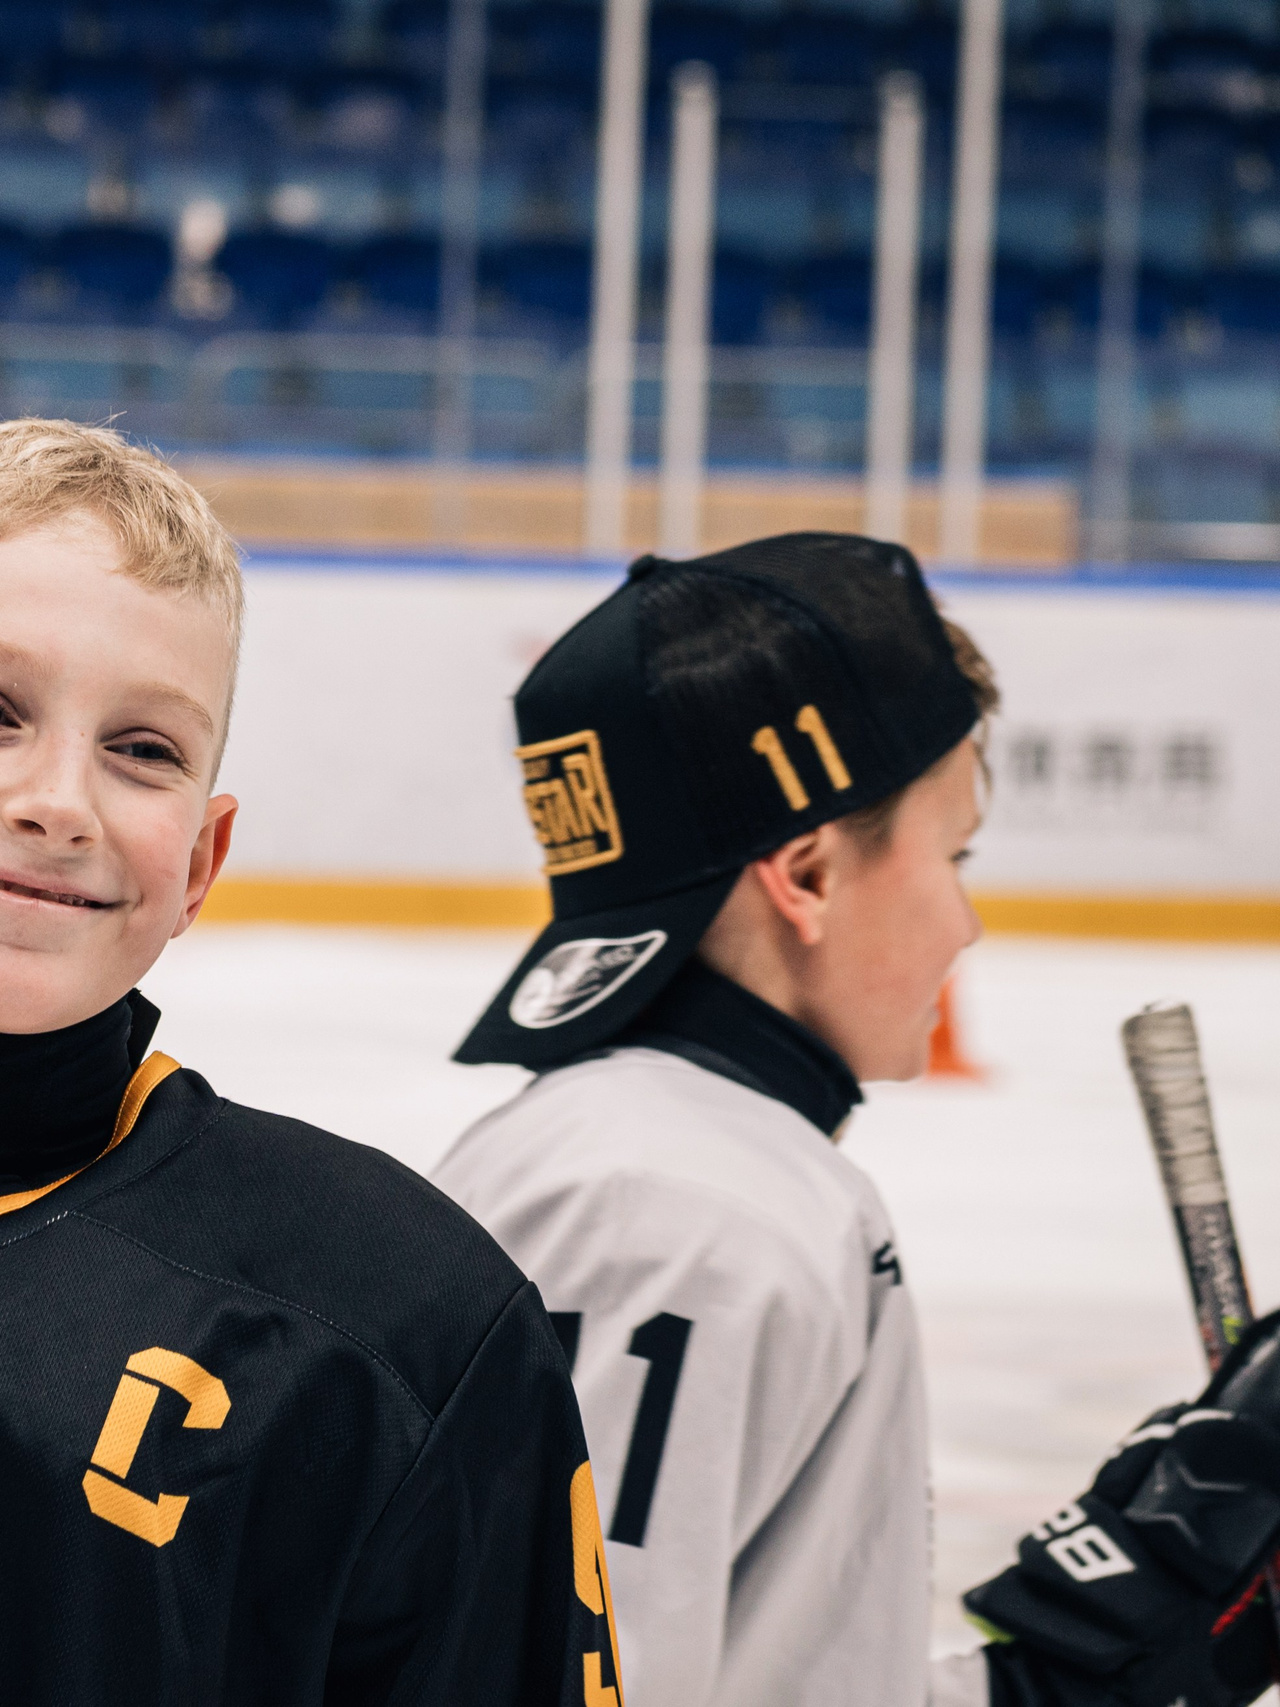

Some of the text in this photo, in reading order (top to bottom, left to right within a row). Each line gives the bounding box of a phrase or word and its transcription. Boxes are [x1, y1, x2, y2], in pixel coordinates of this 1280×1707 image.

[751, 704, 852, 811] 11
[81, 1346, 232, 1548] C
[548, 1311, 695, 1549] 1
